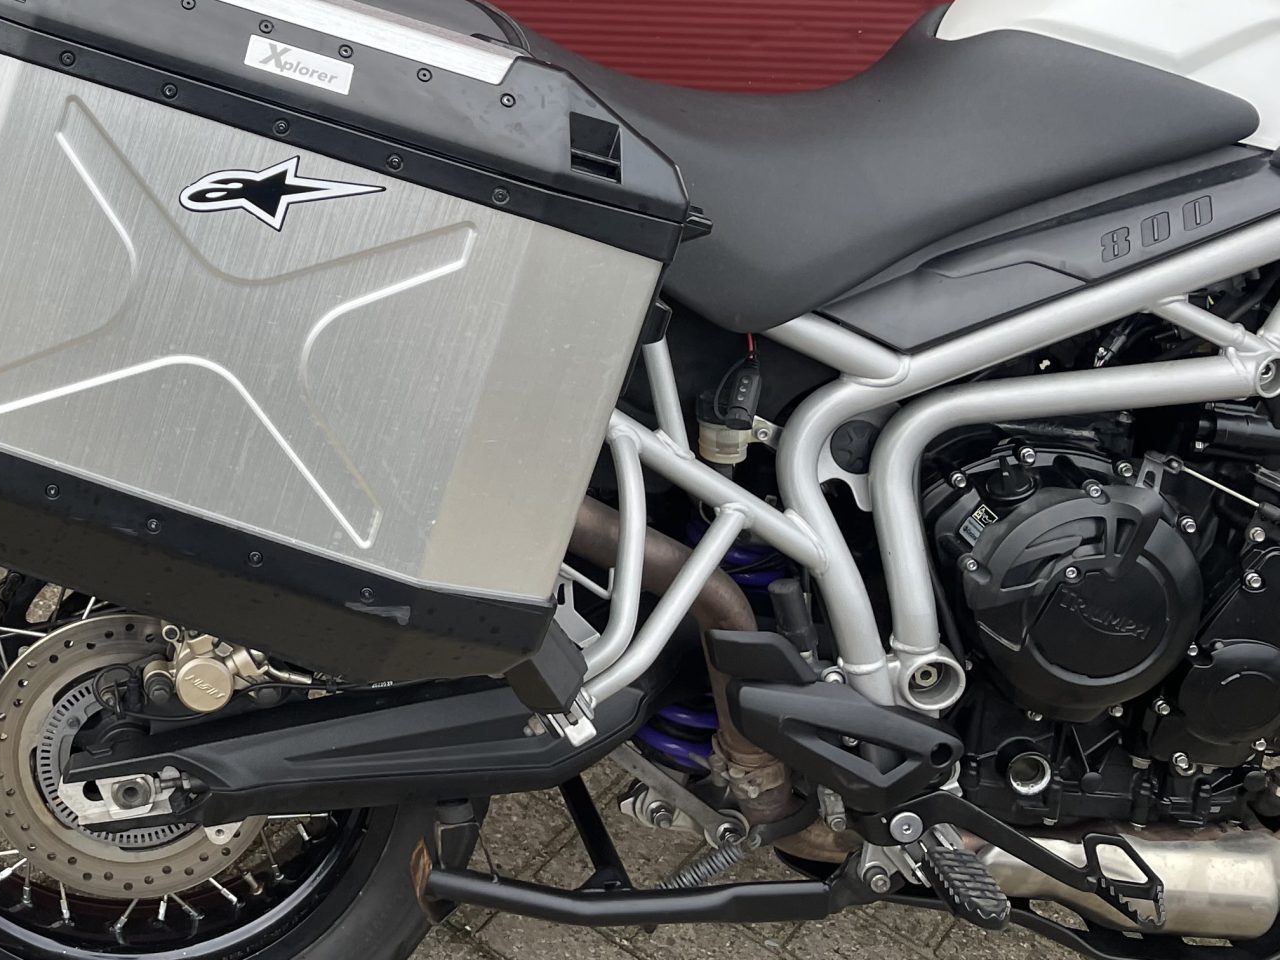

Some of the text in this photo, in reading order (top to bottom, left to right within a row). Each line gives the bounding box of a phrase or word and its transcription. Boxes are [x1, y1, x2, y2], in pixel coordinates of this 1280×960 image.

[259, 43, 338, 84] Xplorer
[1100, 195, 1213, 263] 800
[1060, 588, 1150, 640] TRIUMPH
